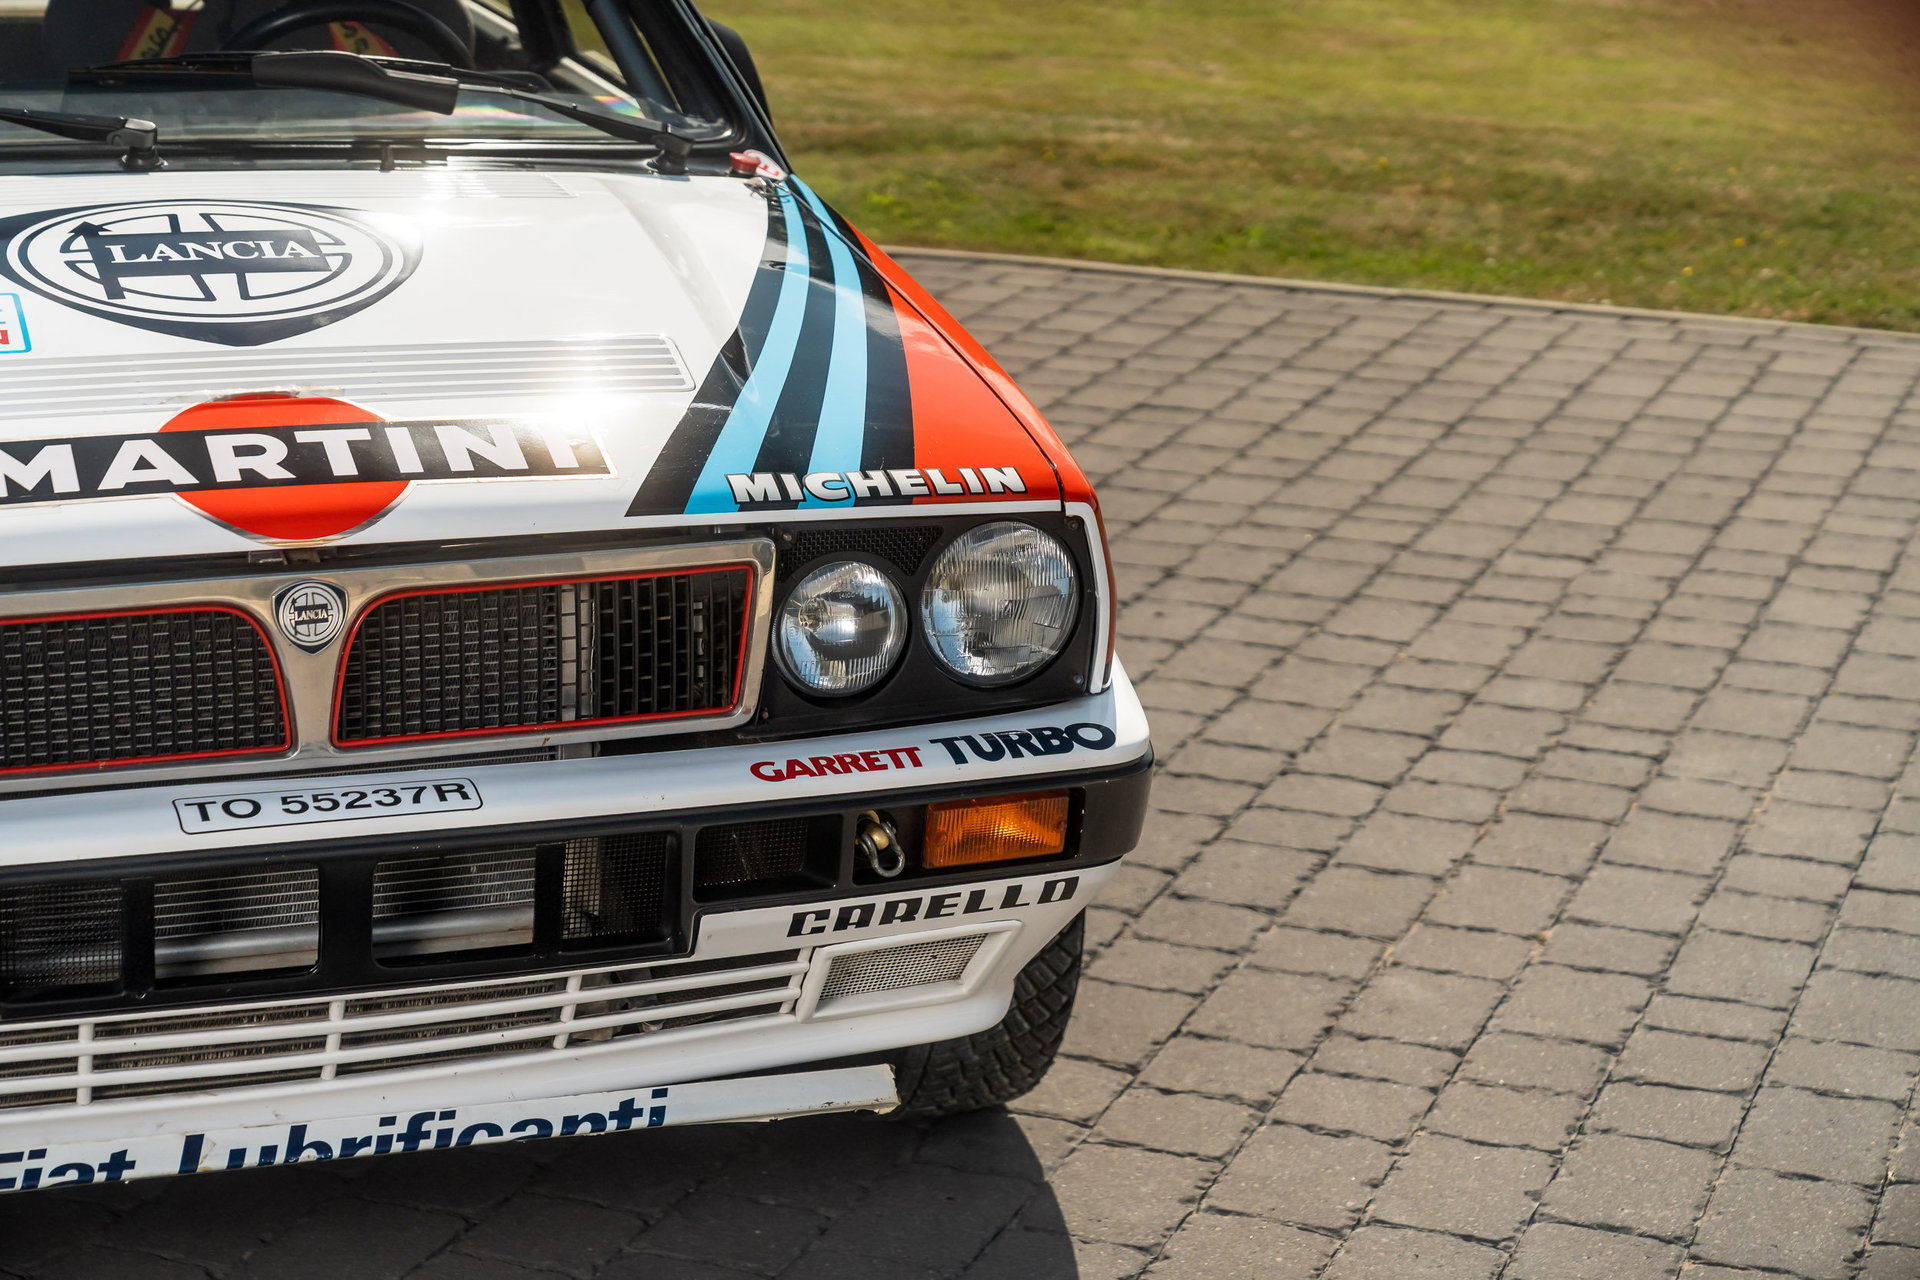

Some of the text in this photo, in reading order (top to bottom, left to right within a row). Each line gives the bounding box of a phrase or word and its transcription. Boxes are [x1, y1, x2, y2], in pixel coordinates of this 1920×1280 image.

[105, 239, 321, 263] LANCIA
[0, 422, 580, 498] MARTINI
[725, 466, 1028, 504] MICHELIN
[294, 608, 329, 622] LANCIA
[749, 722, 1117, 782] GARRETT TURBO
[184, 782, 472, 822] TO 55237R
[786, 876, 1080, 938] CARELLO
